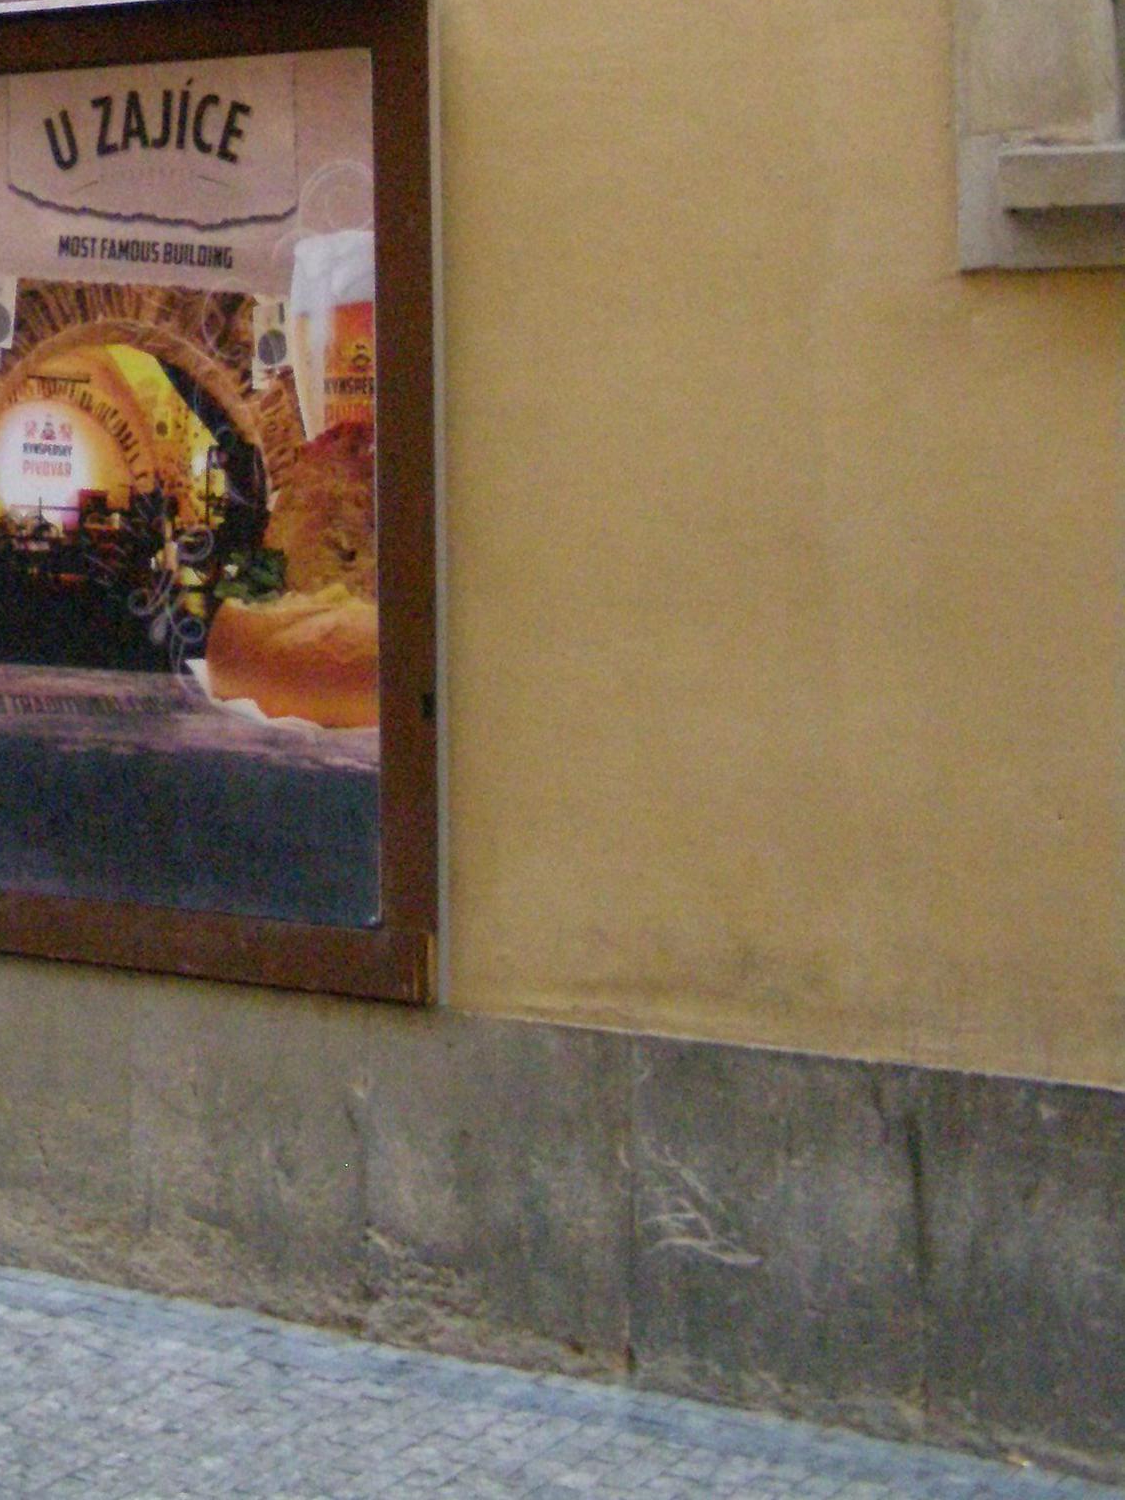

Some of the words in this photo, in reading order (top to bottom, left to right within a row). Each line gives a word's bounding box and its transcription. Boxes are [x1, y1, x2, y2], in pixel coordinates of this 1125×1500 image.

[43, 109, 79, 172] U
[90, 76, 253, 165] ZAJÍCE
[57, 235, 97, 258] MOST
[100, 237, 160, 264] FAMOUS
[162, 241, 234, 270] BUILDING
[22, 459, 73, 477] PIVOVAR
